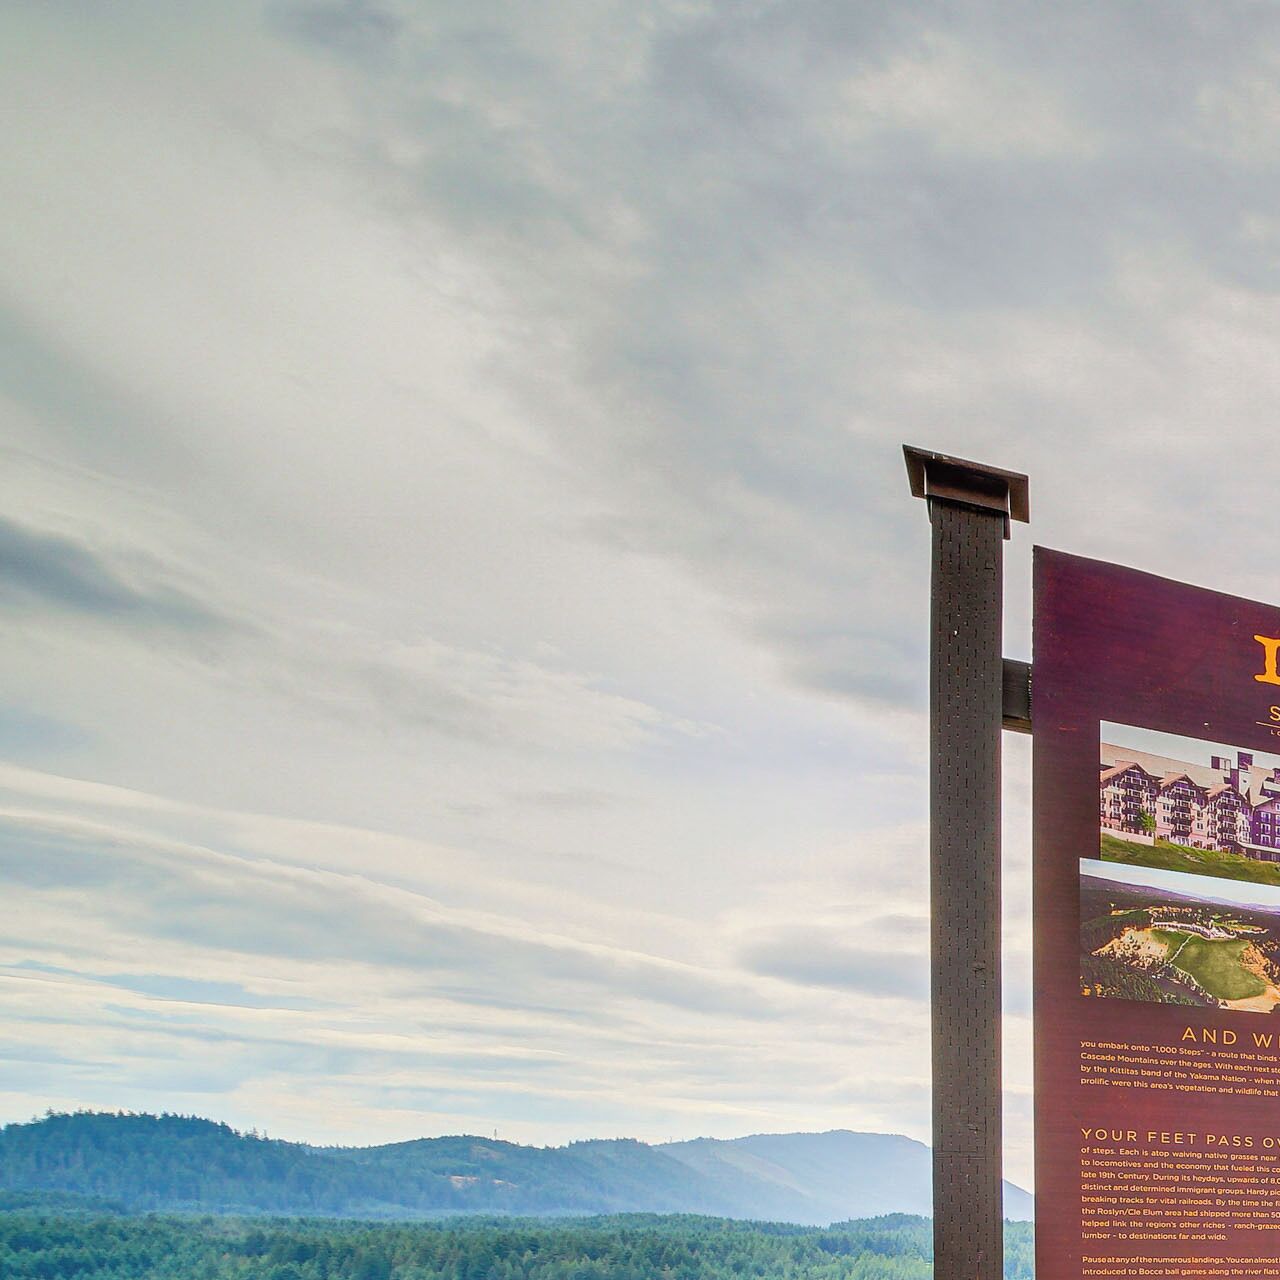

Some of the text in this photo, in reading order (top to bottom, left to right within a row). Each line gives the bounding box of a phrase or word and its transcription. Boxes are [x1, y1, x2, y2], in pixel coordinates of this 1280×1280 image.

[1182, 1027, 1237, 1045] AND
[1080, 1052, 1115, 1061] Cascade
[1117, 1055, 1158, 1064] Mountains
[1253, 1065, 1269, 1073] next
[1080, 1077, 1109, 1087] prolific
[1150, 1082, 1173, 1090] area's
[1175, 1083, 1216, 1094] vegetation
[1218, 1086, 1233, 1094] and
[1234, 1087, 1261, 1096] wildlife
[1263, 1089, 1278, 1097] that
[1081, 1128, 1137, 1141] YOUR
[1148, 1132, 1197, 1144] FEET
[1207, 1135, 1254, 1147] PASS
[1099, 1171, 1115, 1179] 19th
[1152, 1173, 1179, 1182] During
[1227, 1176, 1258, 1185] upwards
[1129, 1184, 1175, 1192] determined
[1176, 1186, 1216, 1195] immigrant
[1246, 1188, 1268, 1196] Hardy
